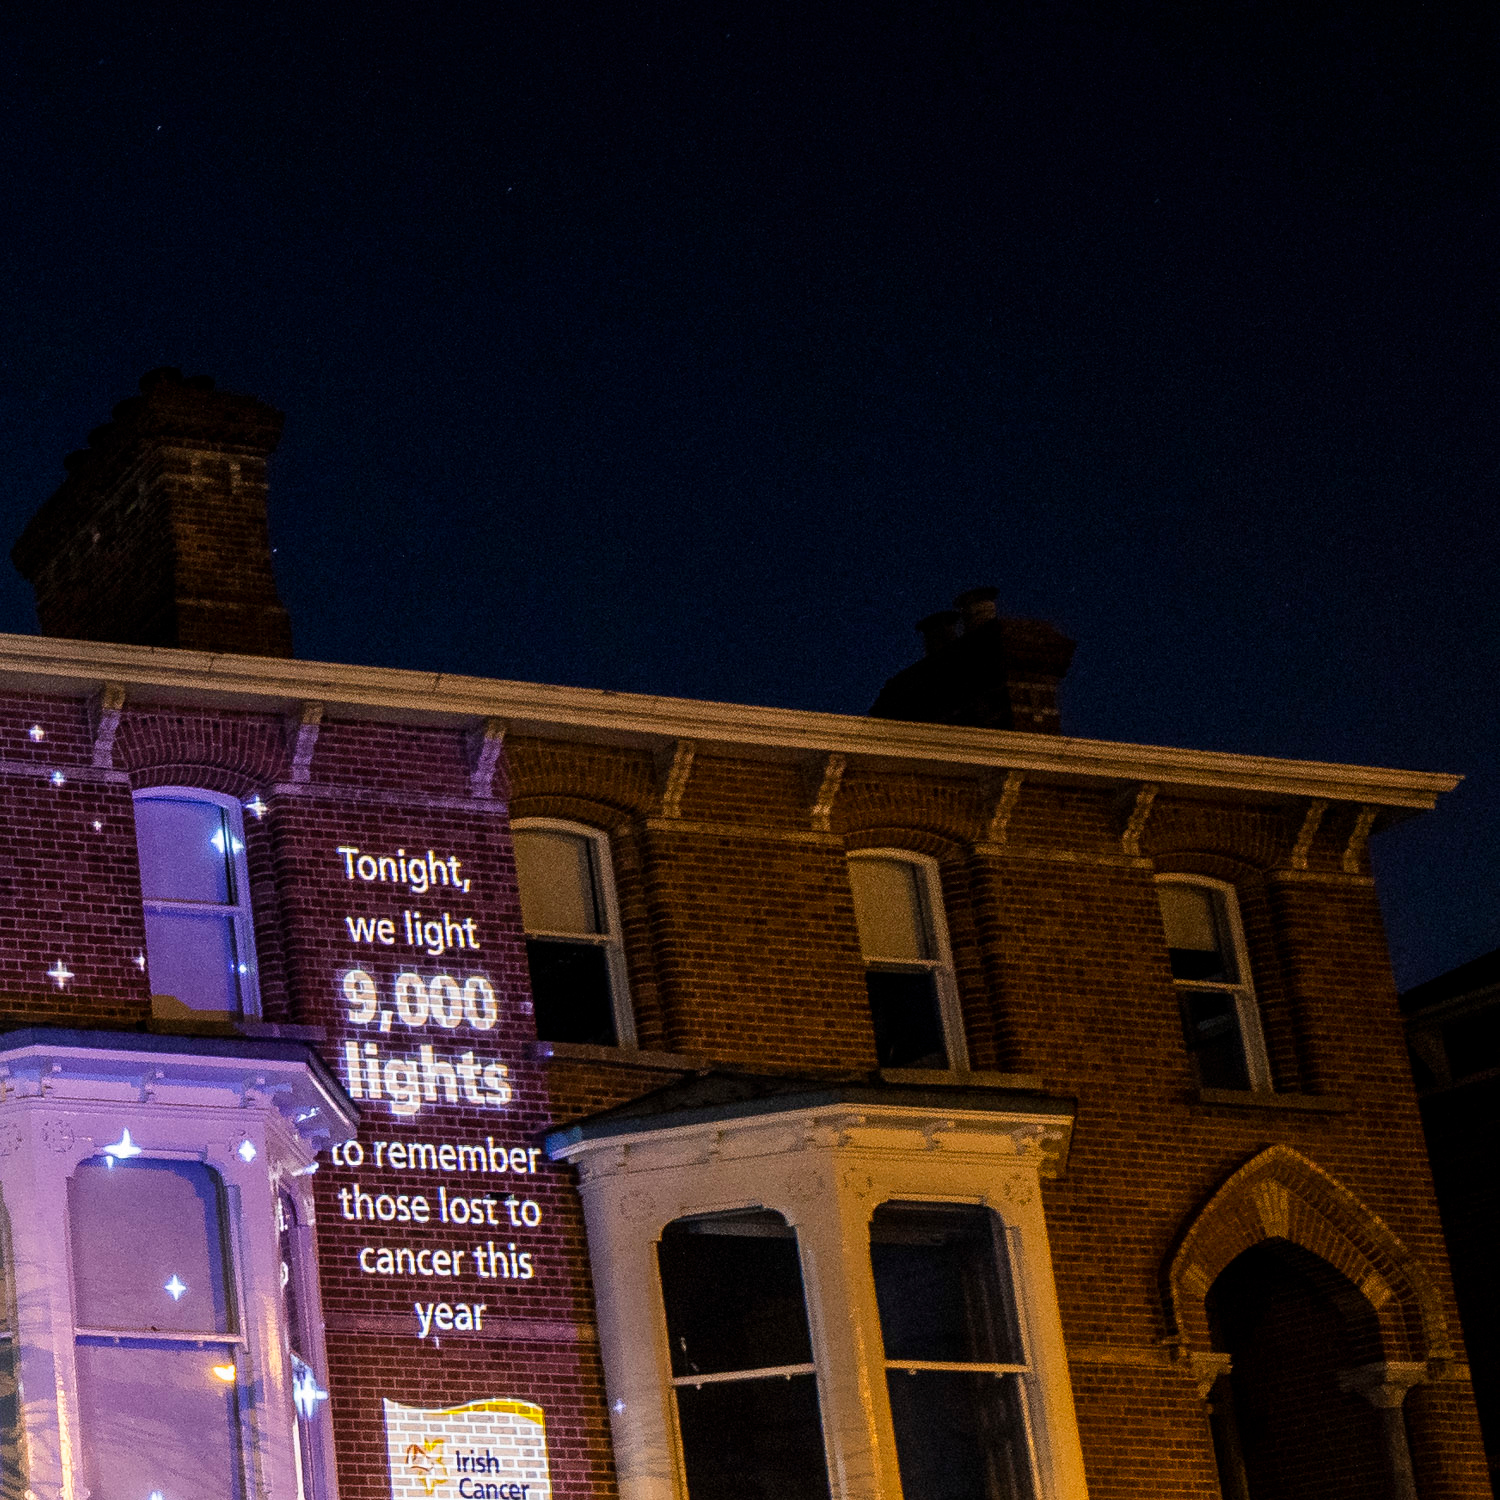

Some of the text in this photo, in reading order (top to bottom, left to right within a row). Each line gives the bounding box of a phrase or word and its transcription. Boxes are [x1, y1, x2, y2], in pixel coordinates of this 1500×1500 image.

[337, 845, 471, 893] Tonight,
[345, 910, 480, 955] we light
[342, 969, 498, 1032] 9,000
[344, 1041, 512, 1116] lights
[331, 1137, 541, 1174] to remember
[338, 1184, 542, 1227] those lost to
[359, 1241, 535, 1279] cancer this
[415, 1301, 487, 1338] year
[455, 1450, 500, 1473] Irish
[459, 1478, 530, 1500] Cancer
